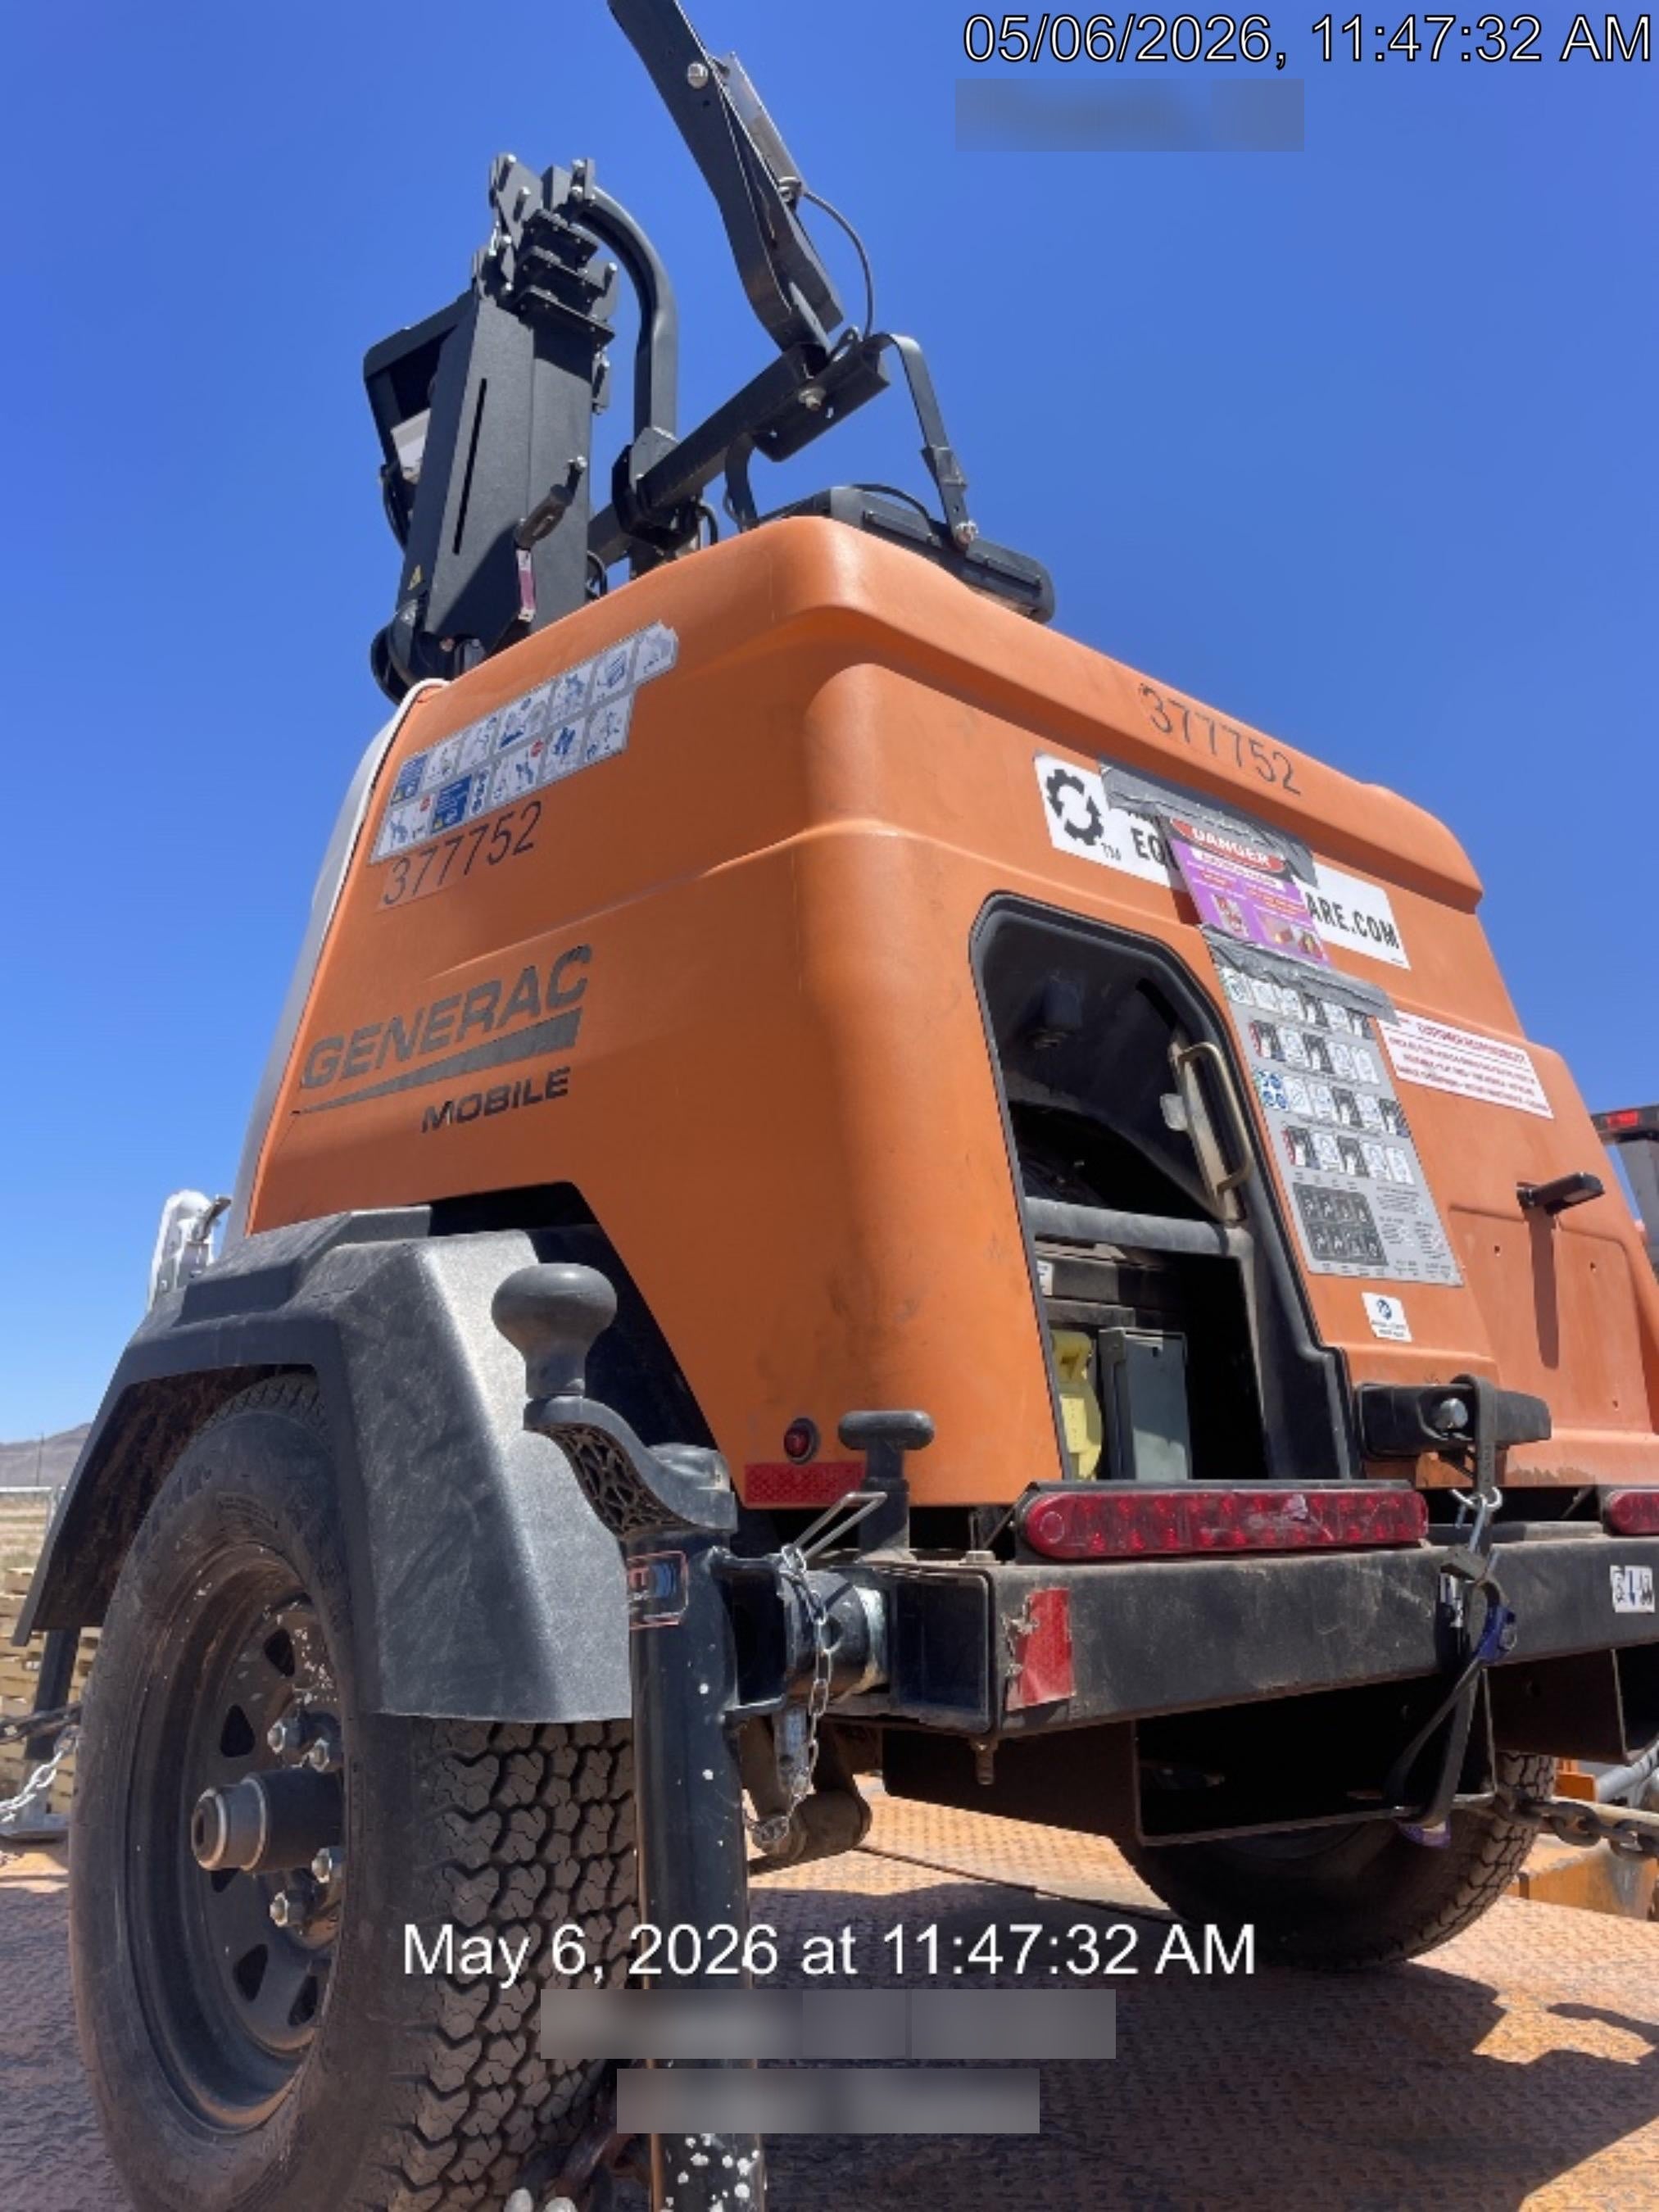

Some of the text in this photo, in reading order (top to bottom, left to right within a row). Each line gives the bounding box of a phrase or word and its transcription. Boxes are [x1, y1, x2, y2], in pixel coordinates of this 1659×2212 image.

[1140, 683, 1301, 796] 377752
[383, 800, 542, 906] 377752
[1305, 891, 1399, 950] ARE.COM
[300, 943, 592, 1089] GENERAC
[421, 1067, 571, 1134] MOBILE
